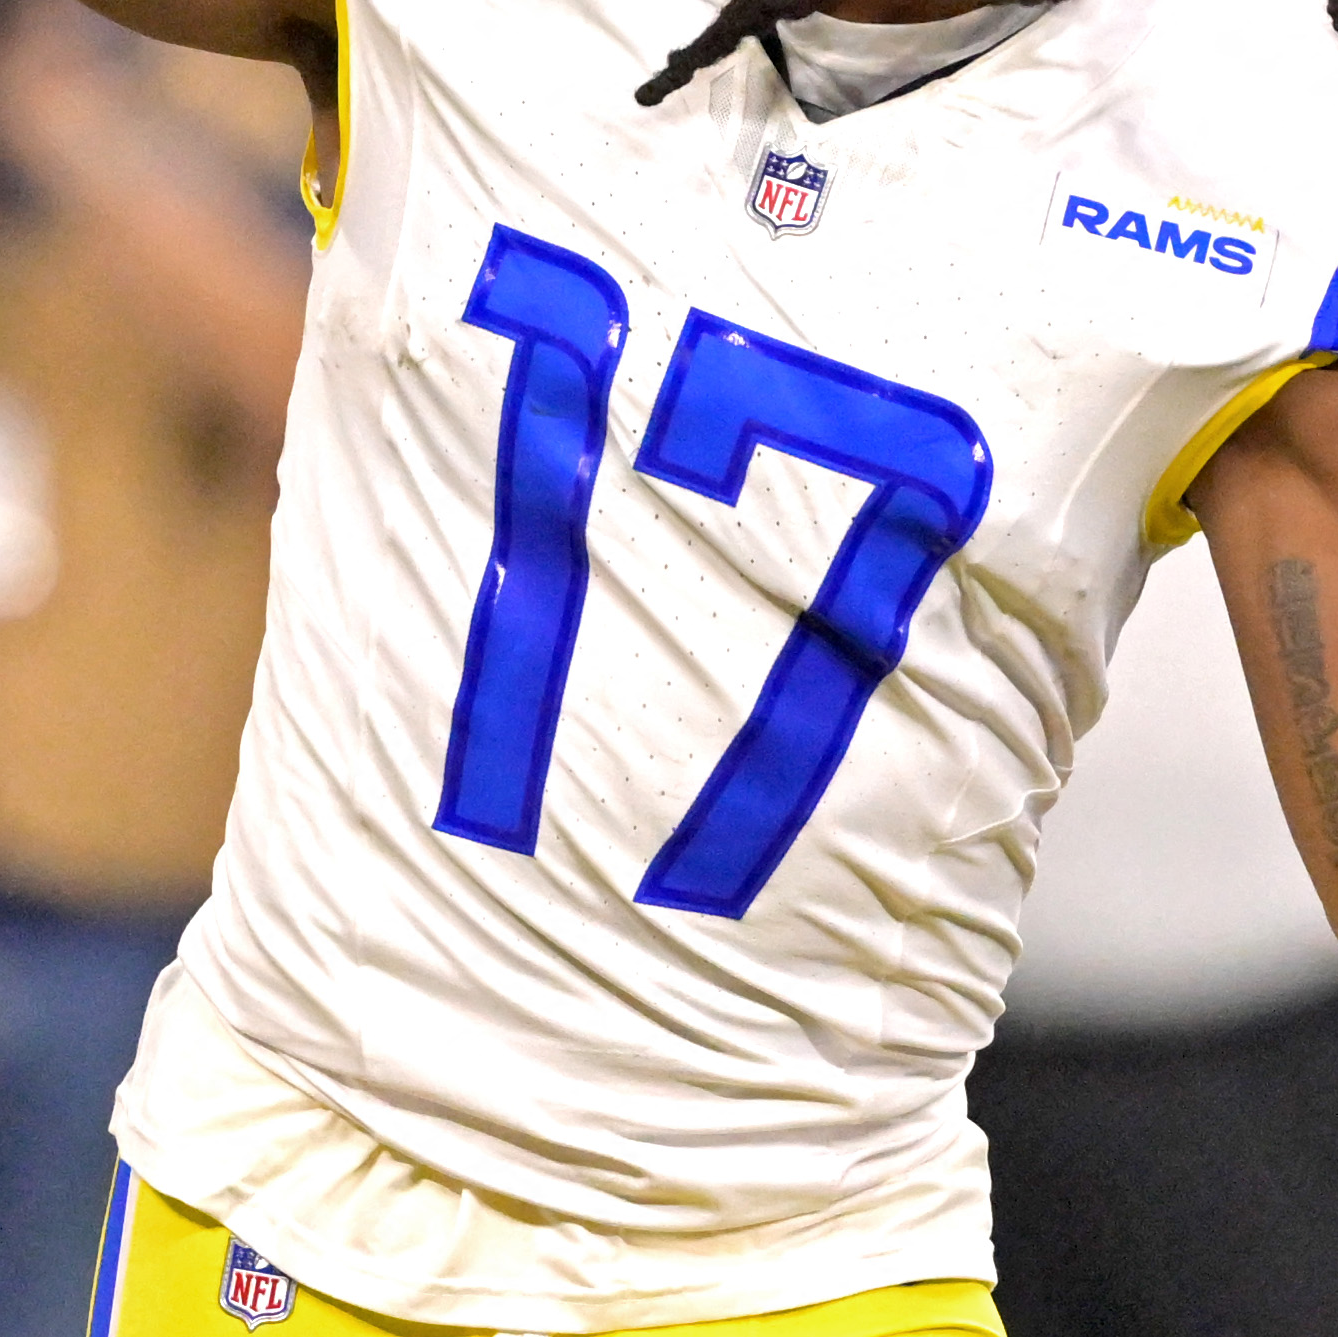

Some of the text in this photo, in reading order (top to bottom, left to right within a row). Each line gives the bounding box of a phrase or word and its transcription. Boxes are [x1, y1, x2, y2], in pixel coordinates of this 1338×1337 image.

[758, 179, 809, 222] NFL
[1062, 194, 1257, 275] RAMS
[432, 222, 994, 919] 17
[230, 1271, 282, 1313] NFL
